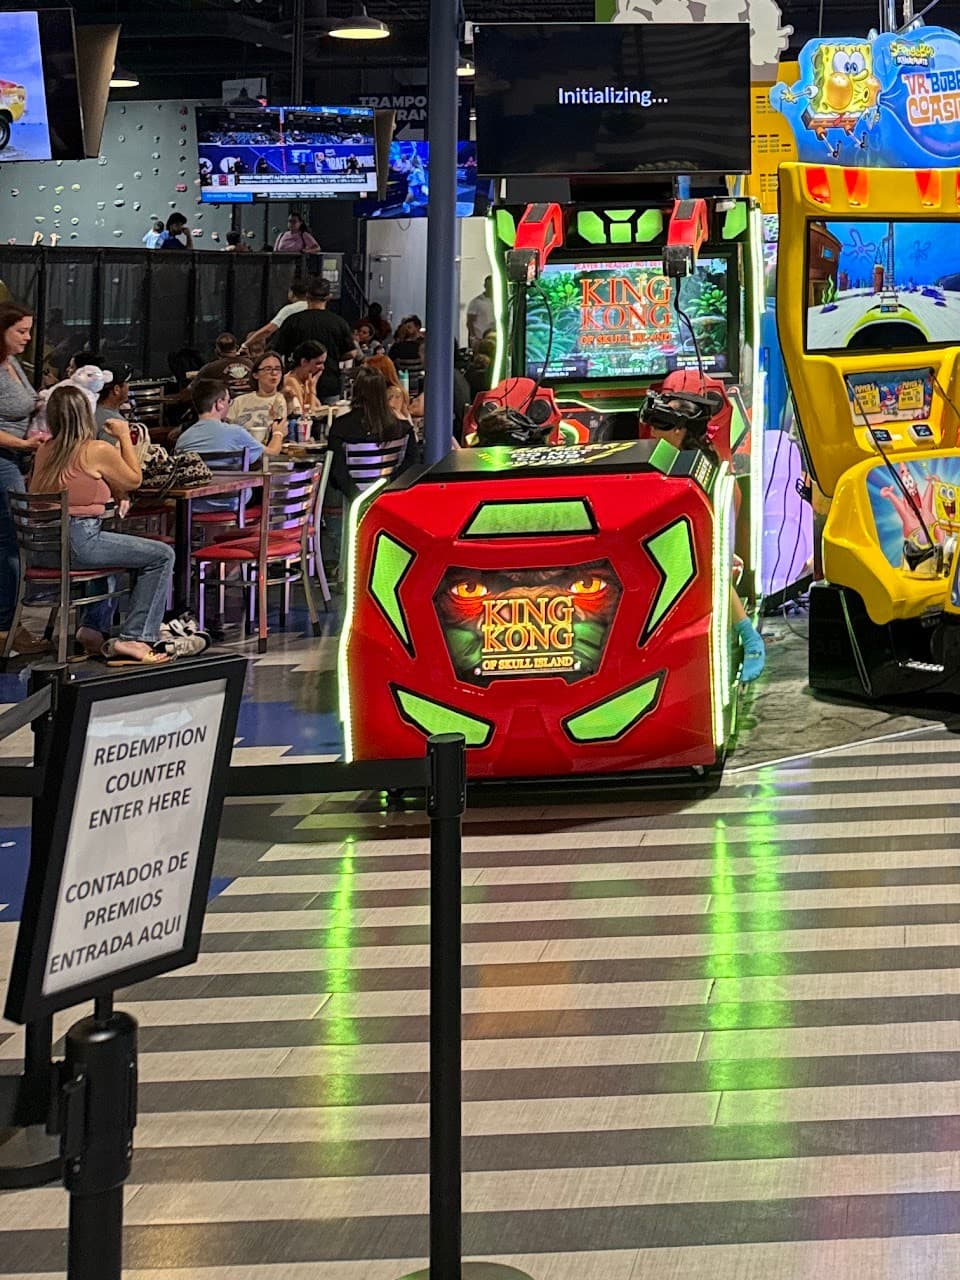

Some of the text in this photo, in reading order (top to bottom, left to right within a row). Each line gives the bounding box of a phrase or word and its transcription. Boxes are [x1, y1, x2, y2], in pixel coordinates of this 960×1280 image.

[557, 86, 669, 108] Initializing...
[903, 73, 930, 96] VR
[579, 274, 673, 306] KING
[580, 305, 672, 331] KONG
[580, 335, 595, 345] OF
[596, 333, 630, 344] SKULL
[482, 595, 575, 627] KING
[481, 623, 575, 653] KONG
[482, 656, 574, 671] OF SKULL ISLAND
[94, 725, 208, 767] REDEMPTION
[105, 759, 187, 794] COUNTER
[88, 787, 192, 830] ENTER HERE
[65, 851, 190, 904] CONTADOR DE
[83, 888, 163, 930] PREMIOS
[49, 915, 182, 975] ENTRADA AQUI
